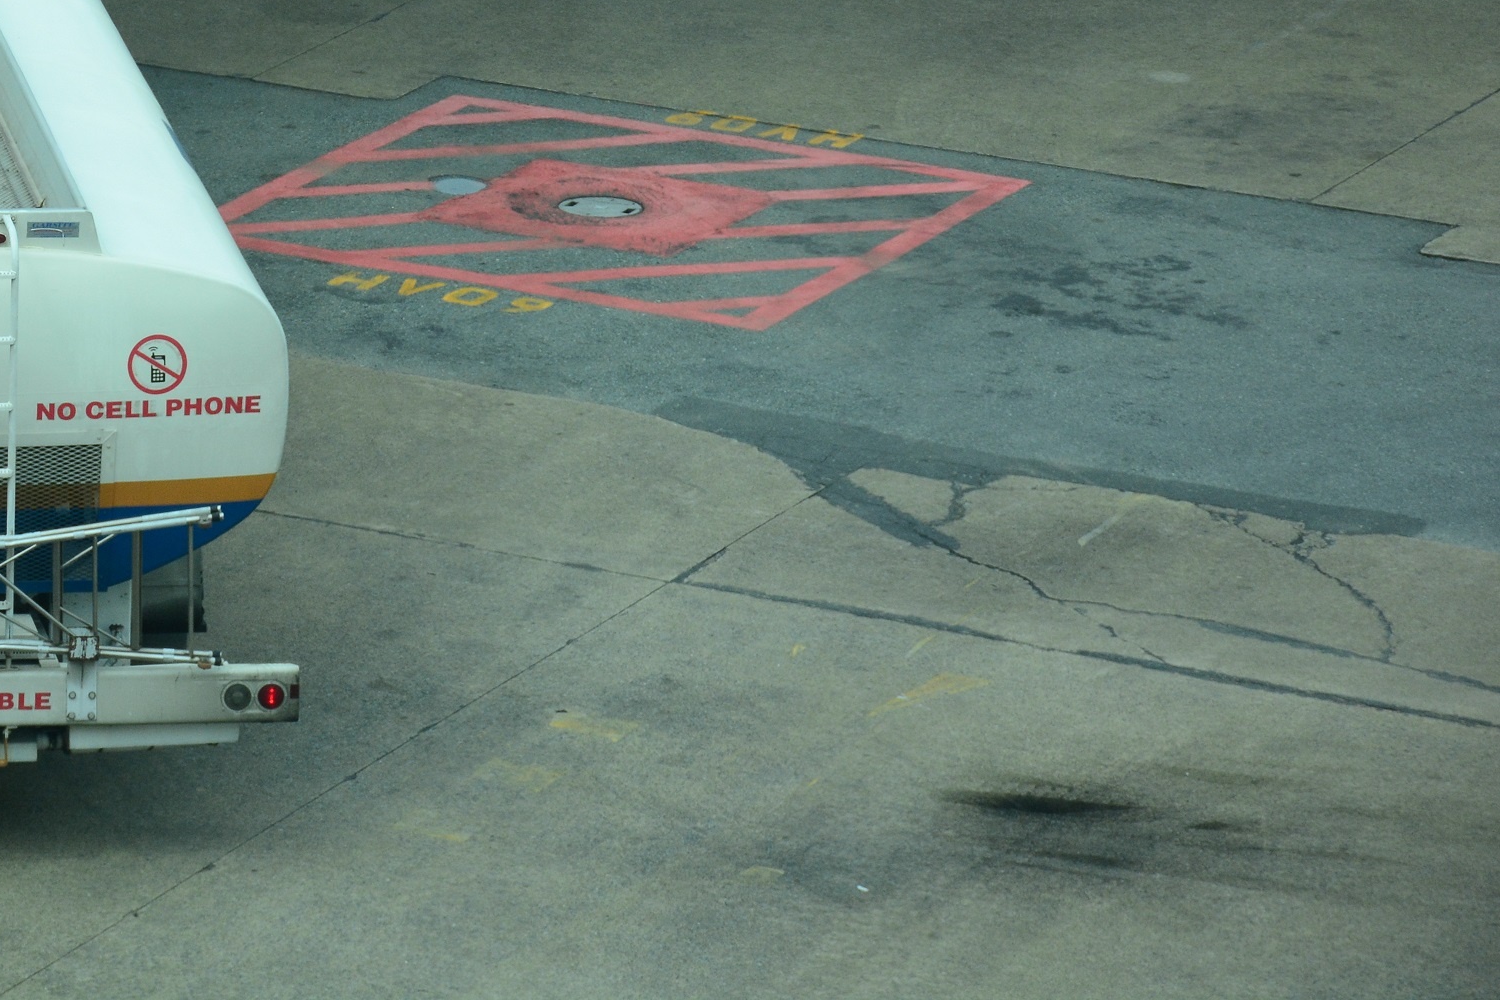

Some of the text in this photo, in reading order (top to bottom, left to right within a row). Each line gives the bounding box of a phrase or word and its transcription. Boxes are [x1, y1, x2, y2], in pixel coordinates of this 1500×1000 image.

[36, 395, 261, 421] NO CELL PHONE
